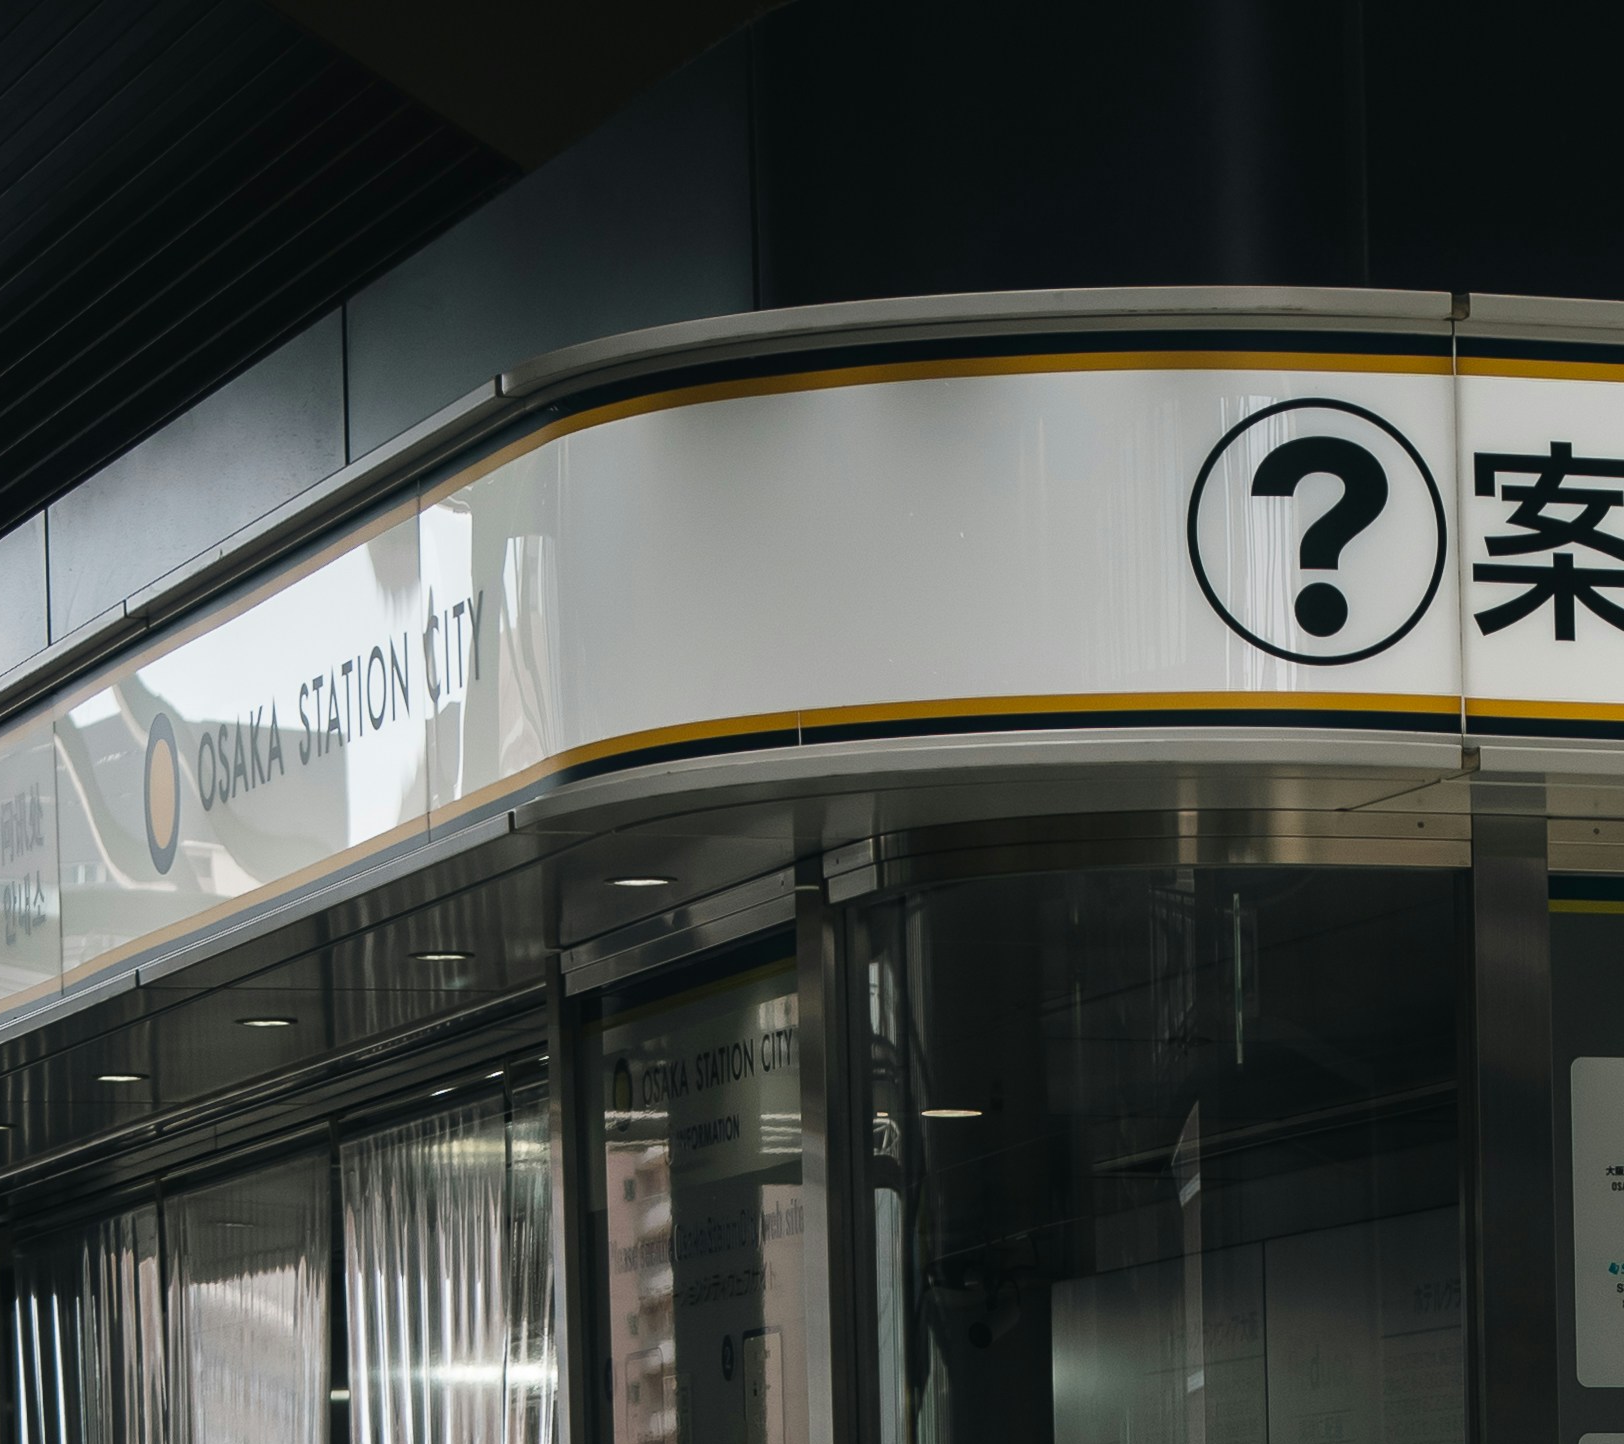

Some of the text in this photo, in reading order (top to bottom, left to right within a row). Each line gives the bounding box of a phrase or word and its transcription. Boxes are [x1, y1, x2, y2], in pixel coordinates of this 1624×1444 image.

[198, 590, 483, 811] OSAKA STATION CITY
[642, 1028, 793, 1106] OSAKA STATION CITY
